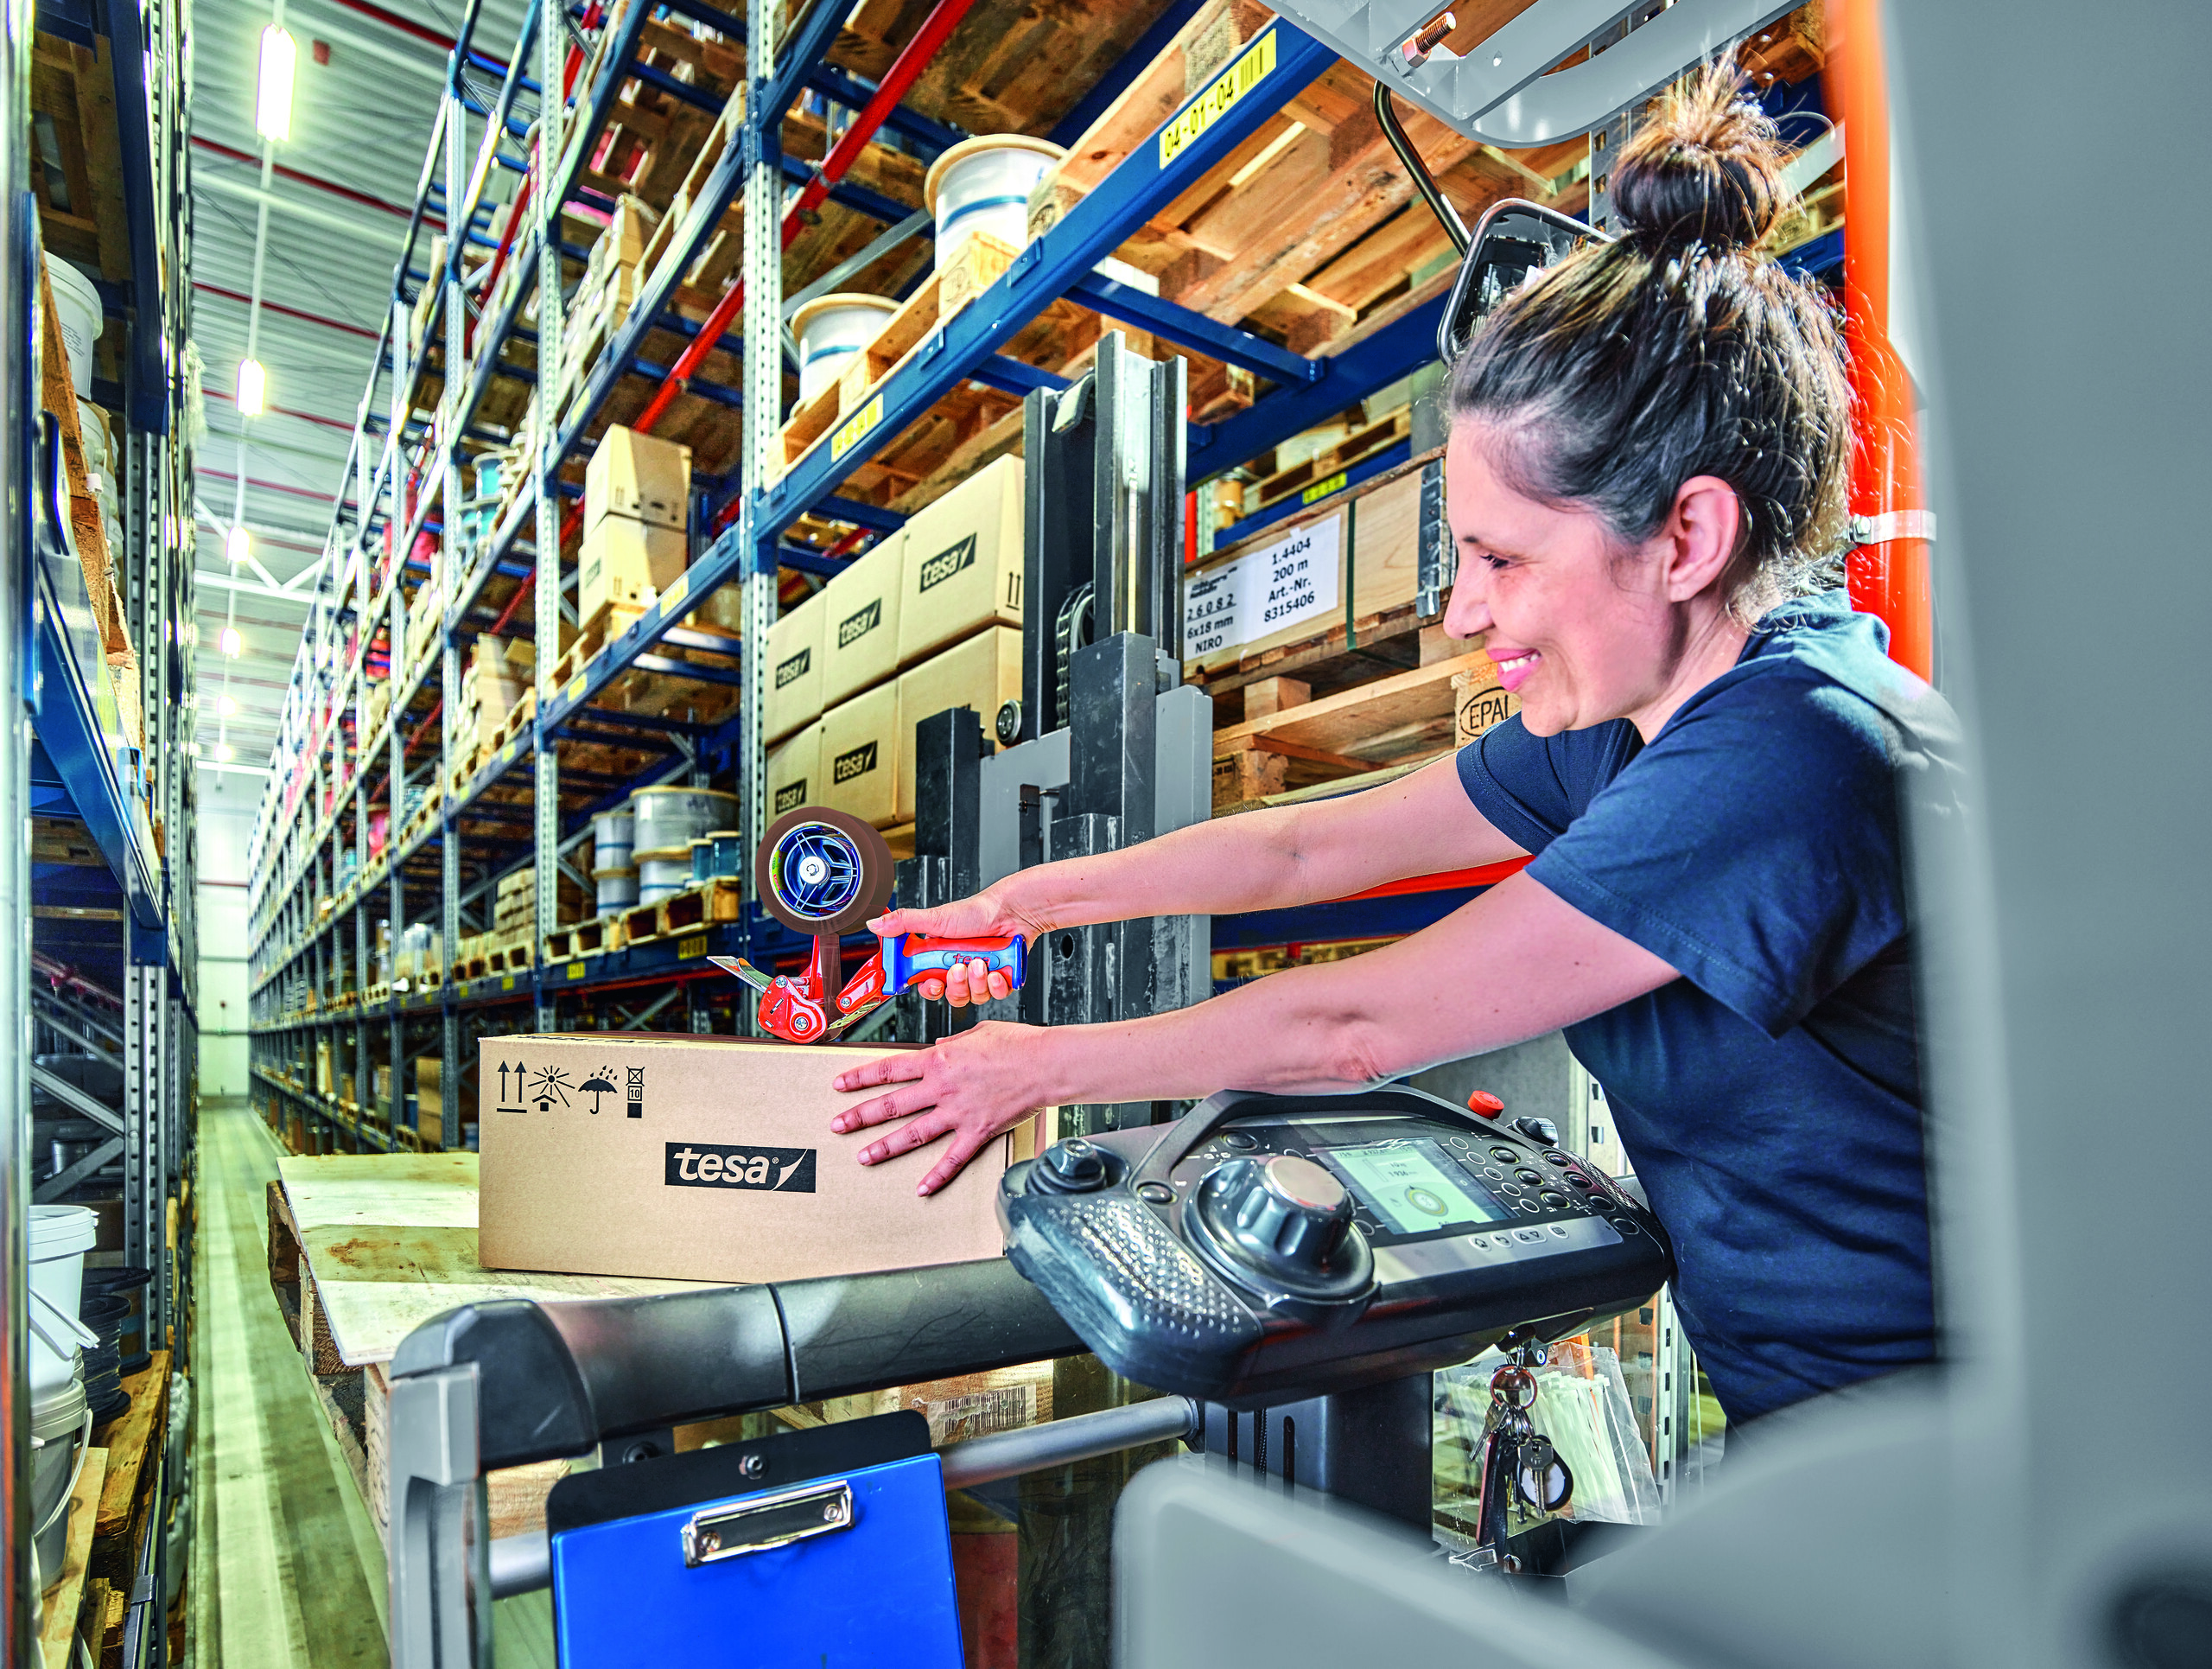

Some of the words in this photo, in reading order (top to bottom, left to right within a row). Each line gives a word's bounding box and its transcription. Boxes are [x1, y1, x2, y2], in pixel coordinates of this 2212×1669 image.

[1165, 74, 1234, 158] 04-01-04
[1273, 537, 1312, 565] 1.4404
[922, 549, 960, 589] tesa
[1273, 564, 1294, 583] 200
[1297, 558, 1308, 572] m
[1264, 590, 1315, 622] 8315406
[841, 613, 868, 645] tesa
[1187, 621, 1212, 640] 6x18
[1214, 615, 1234, 630] mm
[1195, 635, 1223, 654] NIRO
[836, 753, 864, 780] tesa
[953, 953, 990, 968] tea
[630, 1089, 640, 1099] 10
[672, 1147, 772, 1185] tesa
